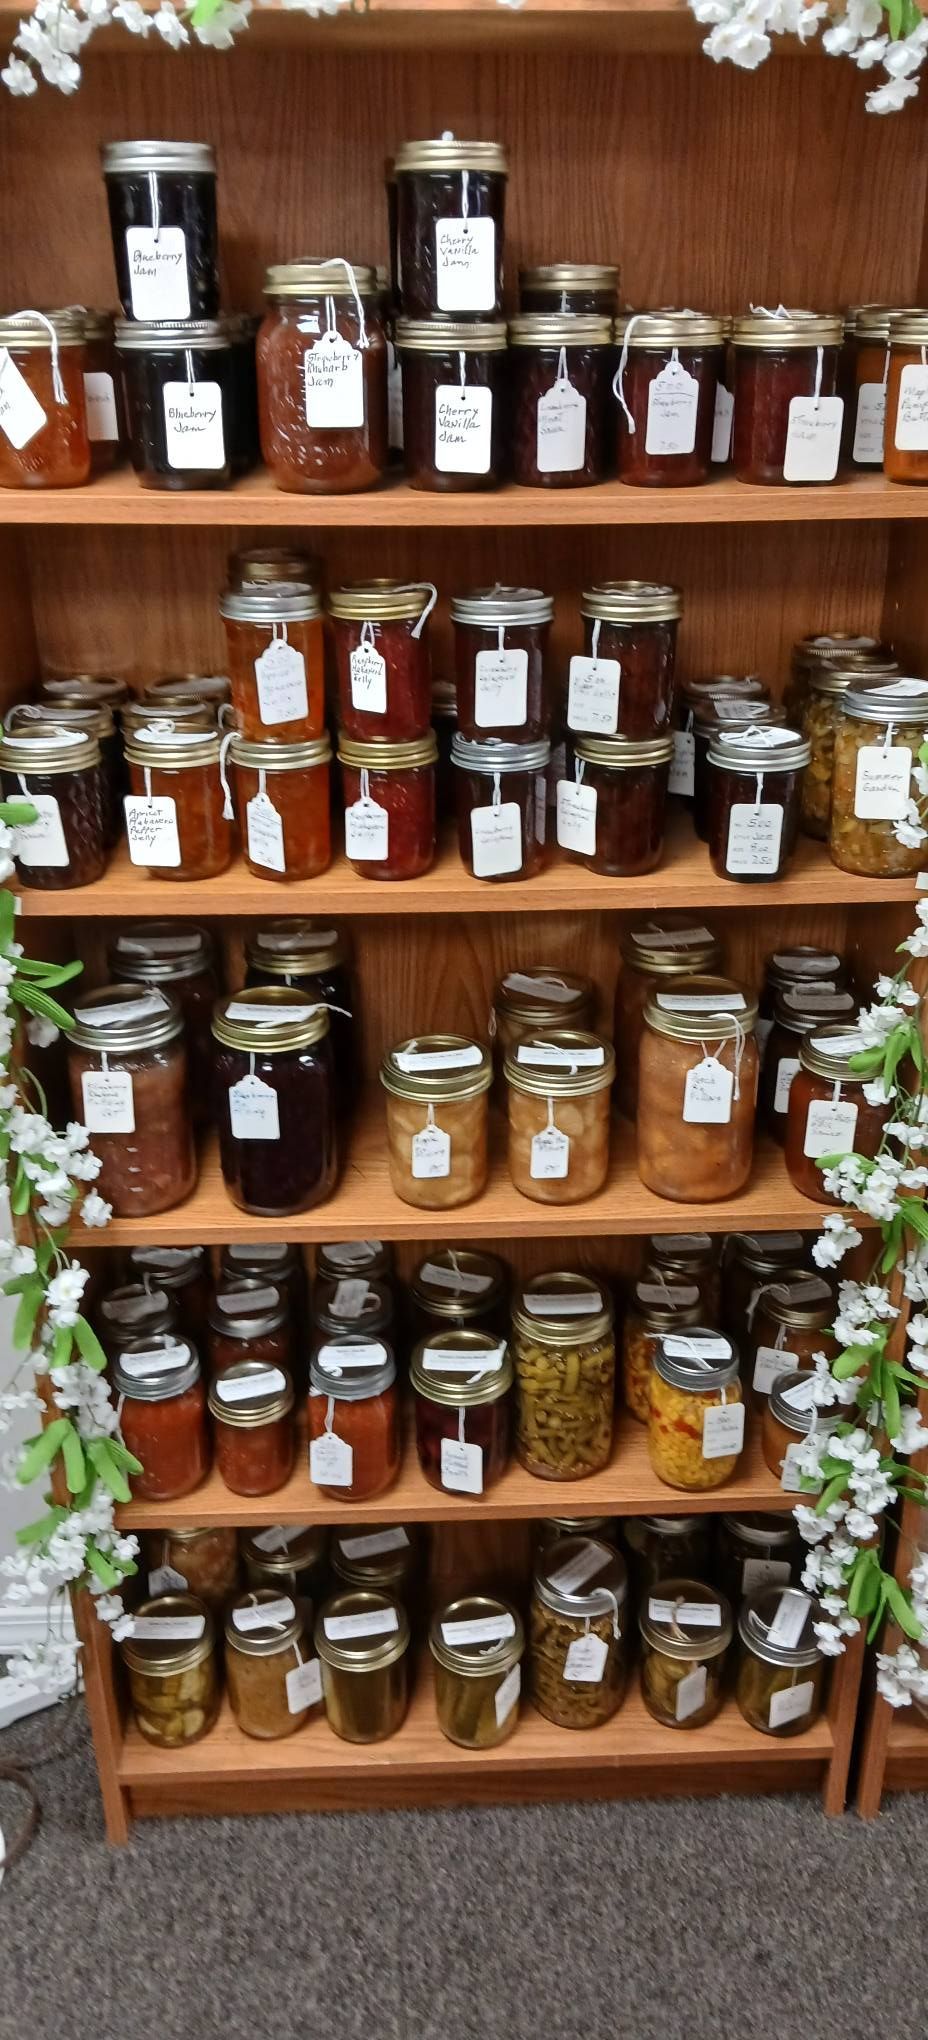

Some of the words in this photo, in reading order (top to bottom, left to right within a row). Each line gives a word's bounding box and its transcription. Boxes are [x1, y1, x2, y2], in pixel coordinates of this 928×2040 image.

[440, 234, 475, 247] Cherry
[439, 246, 480, 256] Vanilla
[133, 265, 157, 277] Jam
[307, 374, 335, 388] Jam
[168, 406, 217, 424] Blueberry
[438, 402, 480, 418] Cherry
[438, 416, 481, 431] Vanilla
